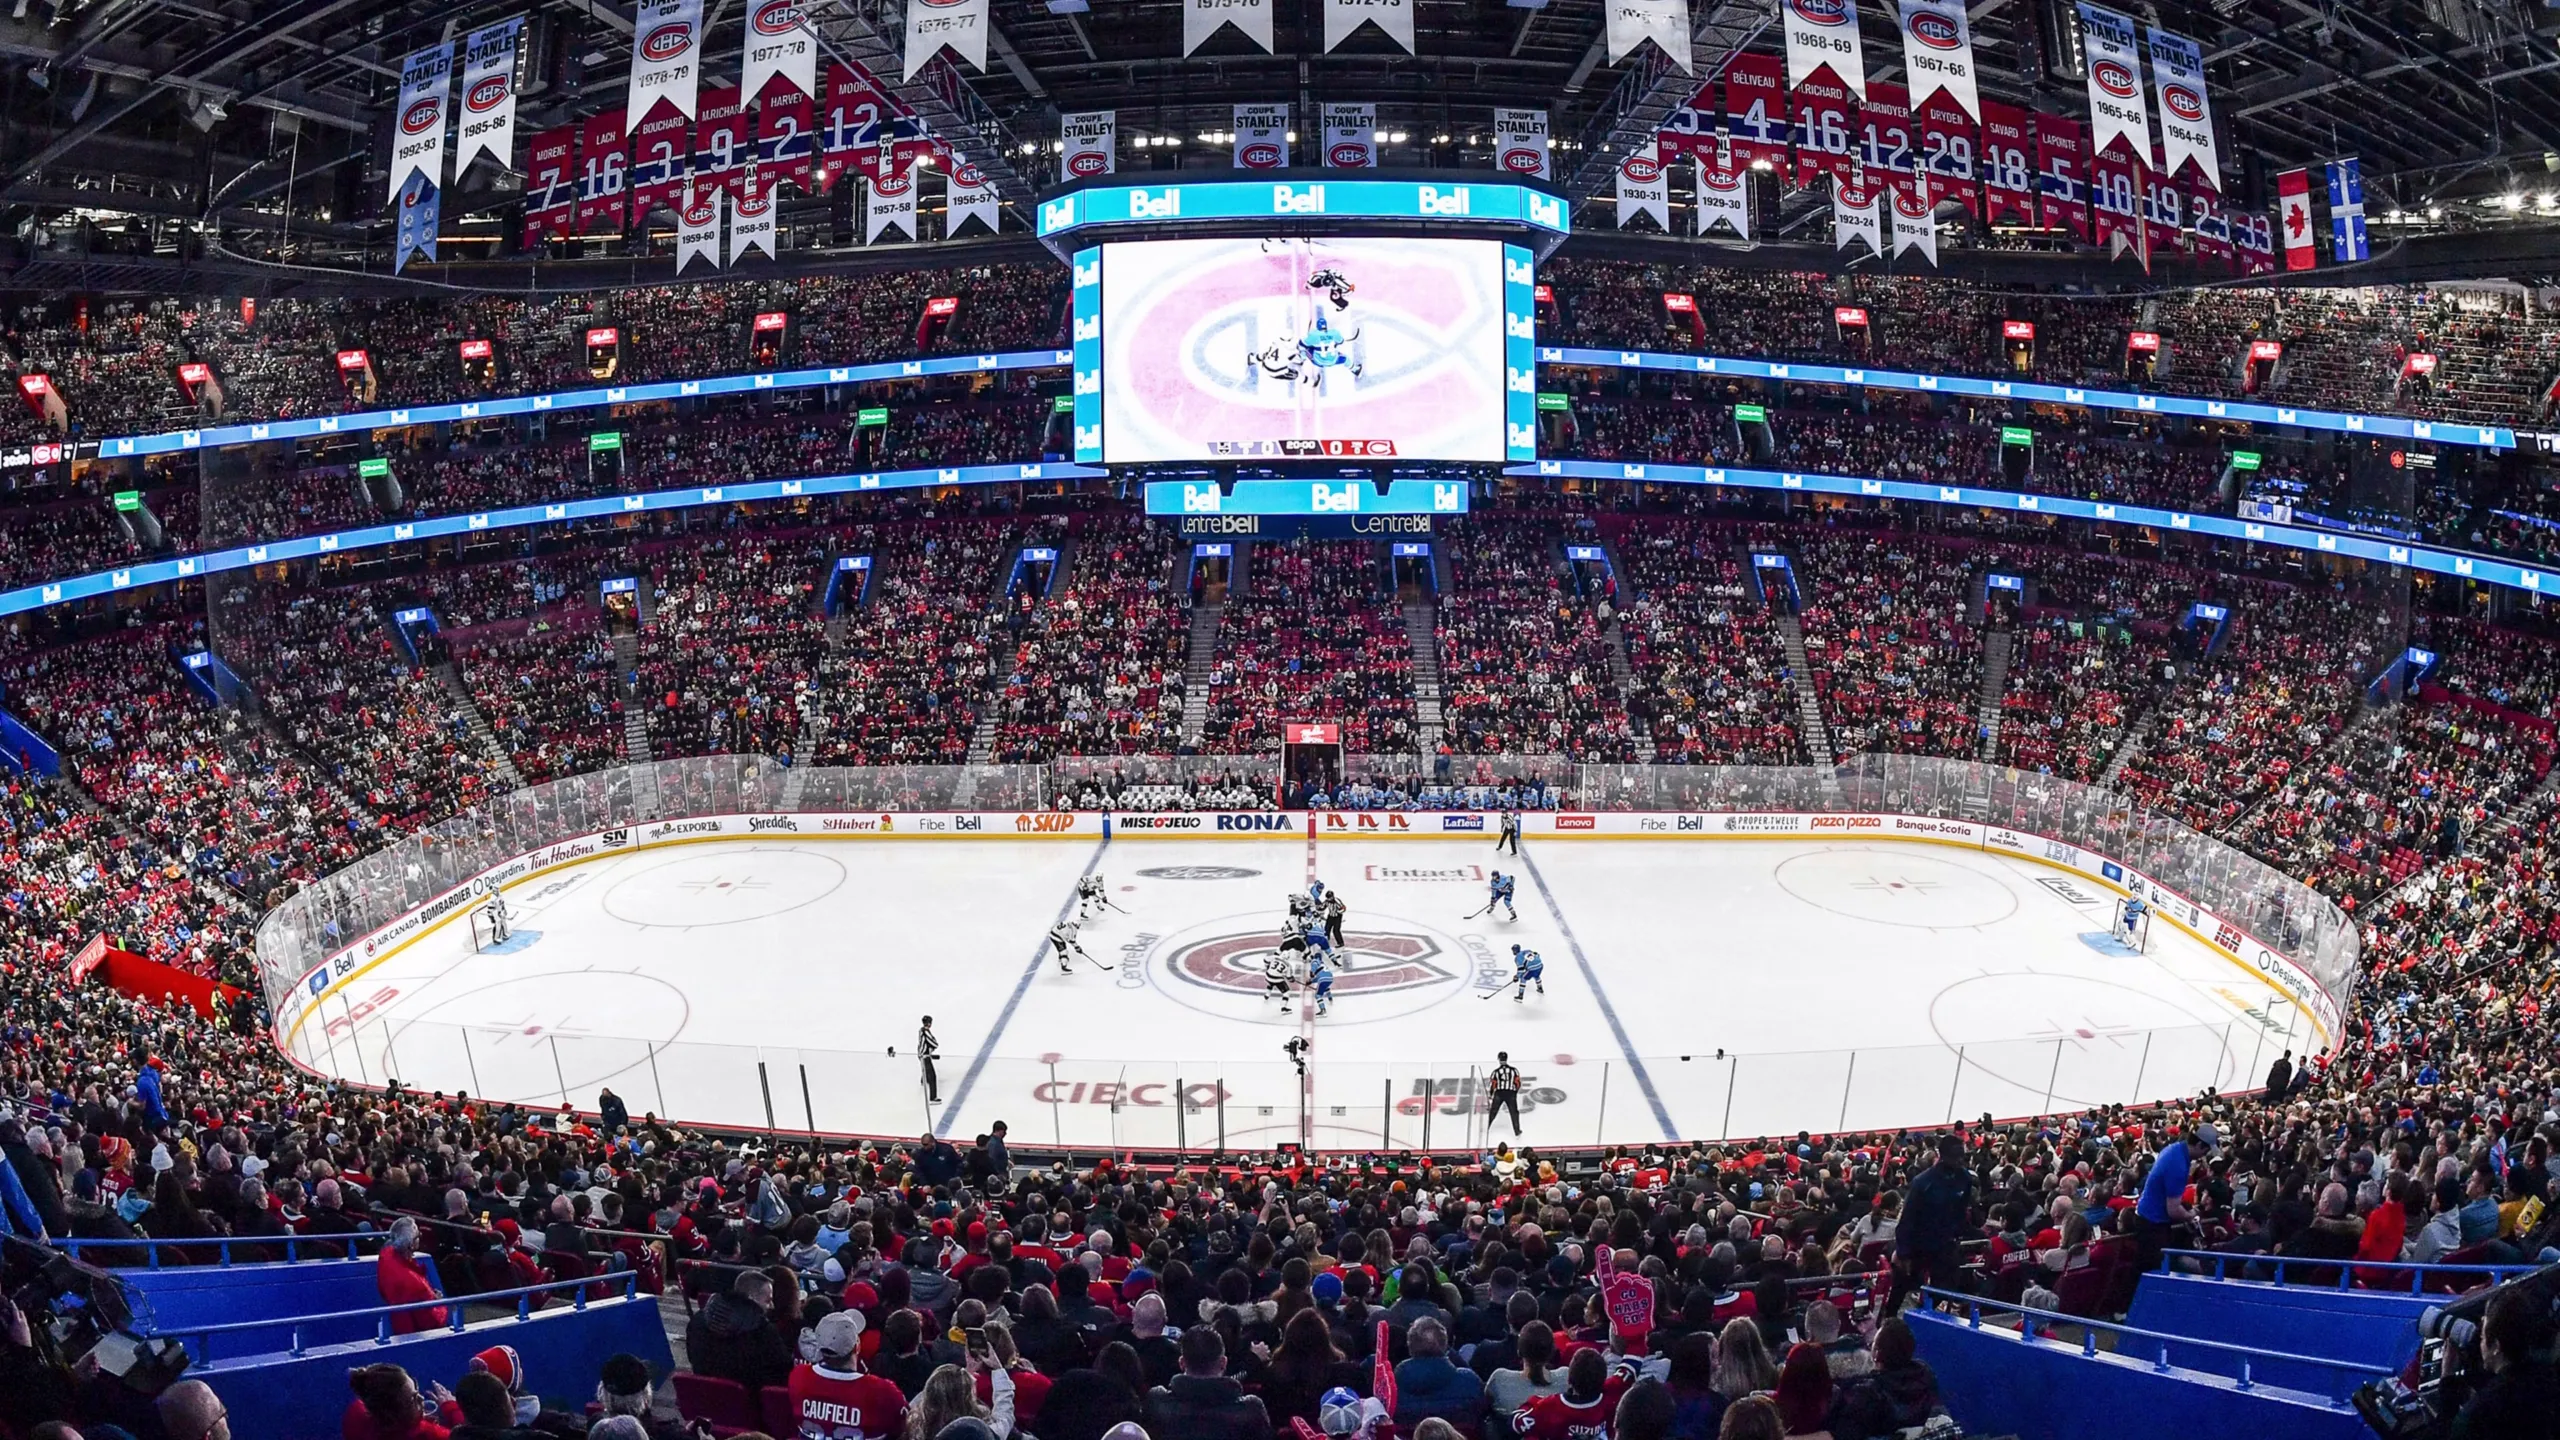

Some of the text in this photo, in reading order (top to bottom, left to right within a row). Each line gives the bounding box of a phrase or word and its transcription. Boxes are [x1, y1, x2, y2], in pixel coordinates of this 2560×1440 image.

[659, 4, 680, 17] CUP
[2091, 9, 2122, 26] COUPE
[917, 13, 977, 34] 1976-77
[2081, 17, 2135, 49] STANLEY
[481, 26, 510, 43] COUPE
[1793, 31, 1852, 53] 1968-69
[2159, 35, 2187, 52] COUPE
[415, 48, 442, 66] COUPE
[467, 33, 518, 64] STANLEY
[751, 41, 806, 63] 1977-78
[2101, 42, 2120, 54] CUP
[2150, 43, 2201, 72] STANLEY
[403, 55, 452, 87] STANLEY
[483, 57, 501, 70] CUP
[1913, 55, 1966, 77] 1967-68
[2170, 65, 2186, 78] CUP
[416, 80, 433, 93] CUP
[639, 65, 689, 88] 1978-79
[1732, 68, 1776, 88] BÉLIVEAU
[838, 80, 872, 96] MOORE
[770, 92, 804, 107] HARVEY
[1858, 99, 1909, 119] COURNOYER
[1075, 115, 1103, 124] COUPE
[1247, 106, 1275, 115] COUPE
[1335, 106, 1363, 115] COUPE
[1508, 112, 1535, 121] COUPE
[1930, 108, 1964, 126] DRYDEN
[2096, 100, 2142, 125] 1965-66
[463, 115, 506, 138] 1985-86
[642, 116, 684, 134] BOUCHARD
[826, 103, 878, 153] 12
[1064, 122, 1113, 138] STANLEY
[1236, 115, 1287, 129] STANLEY
[1324, 114, 1374, 129] STANLEY
[1497, 121, 1547, 134] STANLEY
[1743, 98, 1771, 144] 4
[1799, 105, 1851, 156] 16
[1989, 121, 2019, 139] SAVARD
[596, 131, 616, 146] LACH
[773, 116, 797, 161] 2
[1080, 137, 1096, 146] CUP
[1253, 128, 1269, 137] CUP
[1340, 128, 1357, 137] CUP
[2167, 125, 2209, 148] 1964-65
[399, 138, 436, 161] 1992-93
[536, 144, 566, 161] MORENZ
[711, 128, 733, 174] 9
[1863, 123, 1914, 173] 12
[1925, 131, 1974, 181] 29
[650, 140, 673, 186] 3
[1988, 144, 2031, 193] 18
[579, 151, 625, 202] 16
[2052, 157, 2073, 202] 5
[539, 168, 560, 212] 7
[952, 193, 992, 205] 1956-57
[1274, 185, 1325, 213] Bell
[1622, 188, 1662, 201] 1930-31
[2097, 168, 2135, 217] 10
[873, 202, 911, 216] 1957-58
[1129, 188, 1180, 218] Bell
[1418, 187, 1470, 215] Bell
[1530, 193, 1560, 228] Bell
[1702, 196, 1741, 210] 1929-30
[2144, 181, 2182, 228] 19
[1044, 196, 1075, 230] Bell
[1838, 214, 1875, 228] 1923-24
[681, 231, 715, 245] 1959-60
[735, 222, 770, 235] 1958-59
[1895, 223, 1929, 237] 1915-16
[1075, 259, 1100, 289] Bell
[1506, 257, 1533, 286] Bell
[1075, 312, 1100, 341] Bell
[1506, 311, 1533, 340] Bell
[1075, 366, 1100, 395] Bell
[1506, 365, 1533, 394] Bell
[1075, 422, 1100, 451] Bell
[1506, 421, 1533, 449] Bell
[1330, 440, 1343, 455] 0
[1184, 485, 1220, 512] Bell
[1312, 483, 1360, 511] Bell
[1352, 513, 1431, 533] CentreBell
[749, 815, 798, 832] Shreddies
[919, 817, 946, 831] Fibe
[956, 815, 982, 831] Bell
[1033, 814, 1075, 832] SKIP
[1217, 814, 1293, 831] RONA
[1445, 819, 1483, 830] Lafleur
[1559, 817, 1592, 827] Lenovo
[1641, 817, 1667, 831] Fibe
[1677, 815, 1702, 831] Bell
[1811, 816, 1881, 830] pizza pizza
[1896, 819, 1971, 837] Banque Scotia
[602, 829, 628, 845] SN
[528, 844, 594, 870] Tim Hortons
[484, 862, 527, 889] Desjardins
[1383, 867, 1470, 880] intact
[2051, 878, 2094, 904] Fuel
[2128, 873, 2145, 896] Bell
[420, 886, 472, 925] BOMBARDIER
[389, 916, 420, 942] CANADA
[2213, 923, 2243, 954] IGA
[334, 951, 355, 977] Bell
[2272, 960, 2310, 999] Desjardins
[1033, 1082, 1167, 1106] CIBC
[1620, 1289, 1636, 1300] GO
[1615, 1299, 1648, 1314] HABS
[1623, 1313, 1645, 1326] GO!
[803, 1399, 861, 1427] CAUFIELD
